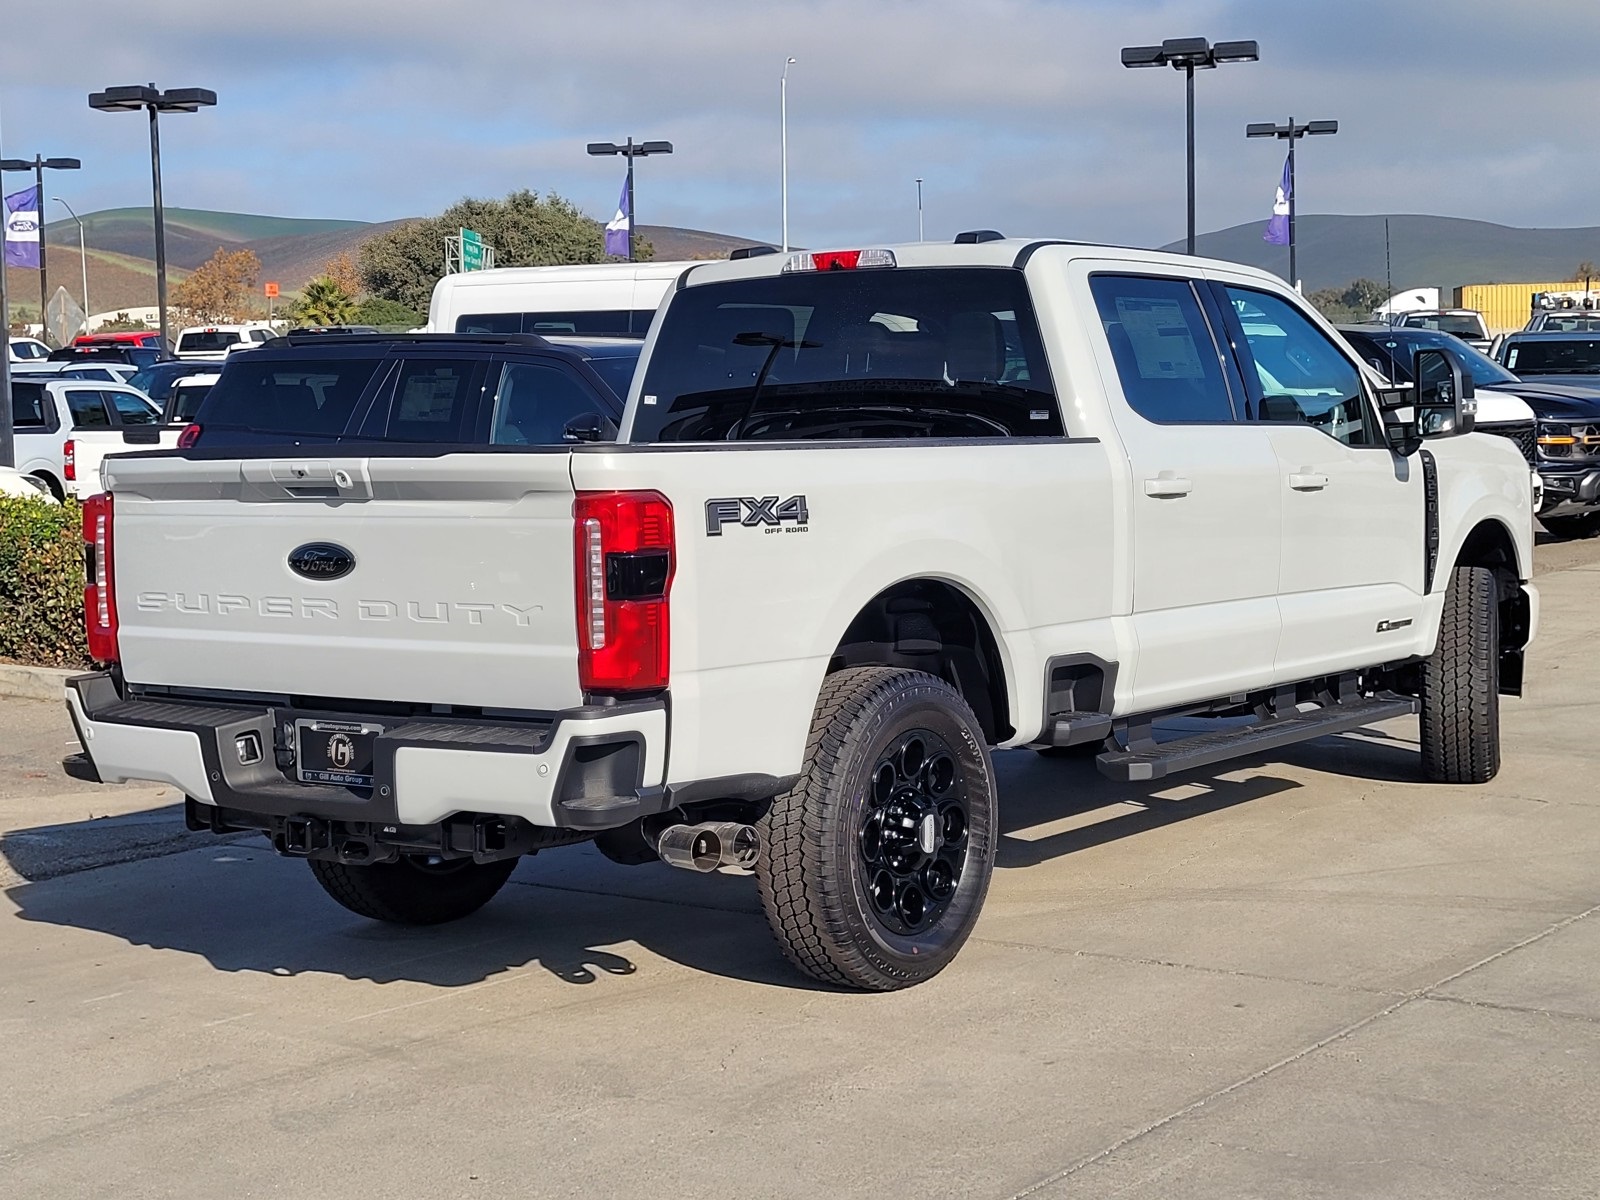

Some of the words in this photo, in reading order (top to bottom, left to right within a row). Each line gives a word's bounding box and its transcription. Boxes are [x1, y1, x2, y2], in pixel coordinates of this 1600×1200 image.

[704, 495, 809, 537] FX4
[297, 550, 337, 571] Ford
[136, 591, 339, 620] SUPER
[358, 599, 544, 627] DUTY
[330, 774, 344, 782] Auto
[345, 776, 363, 784] Group
